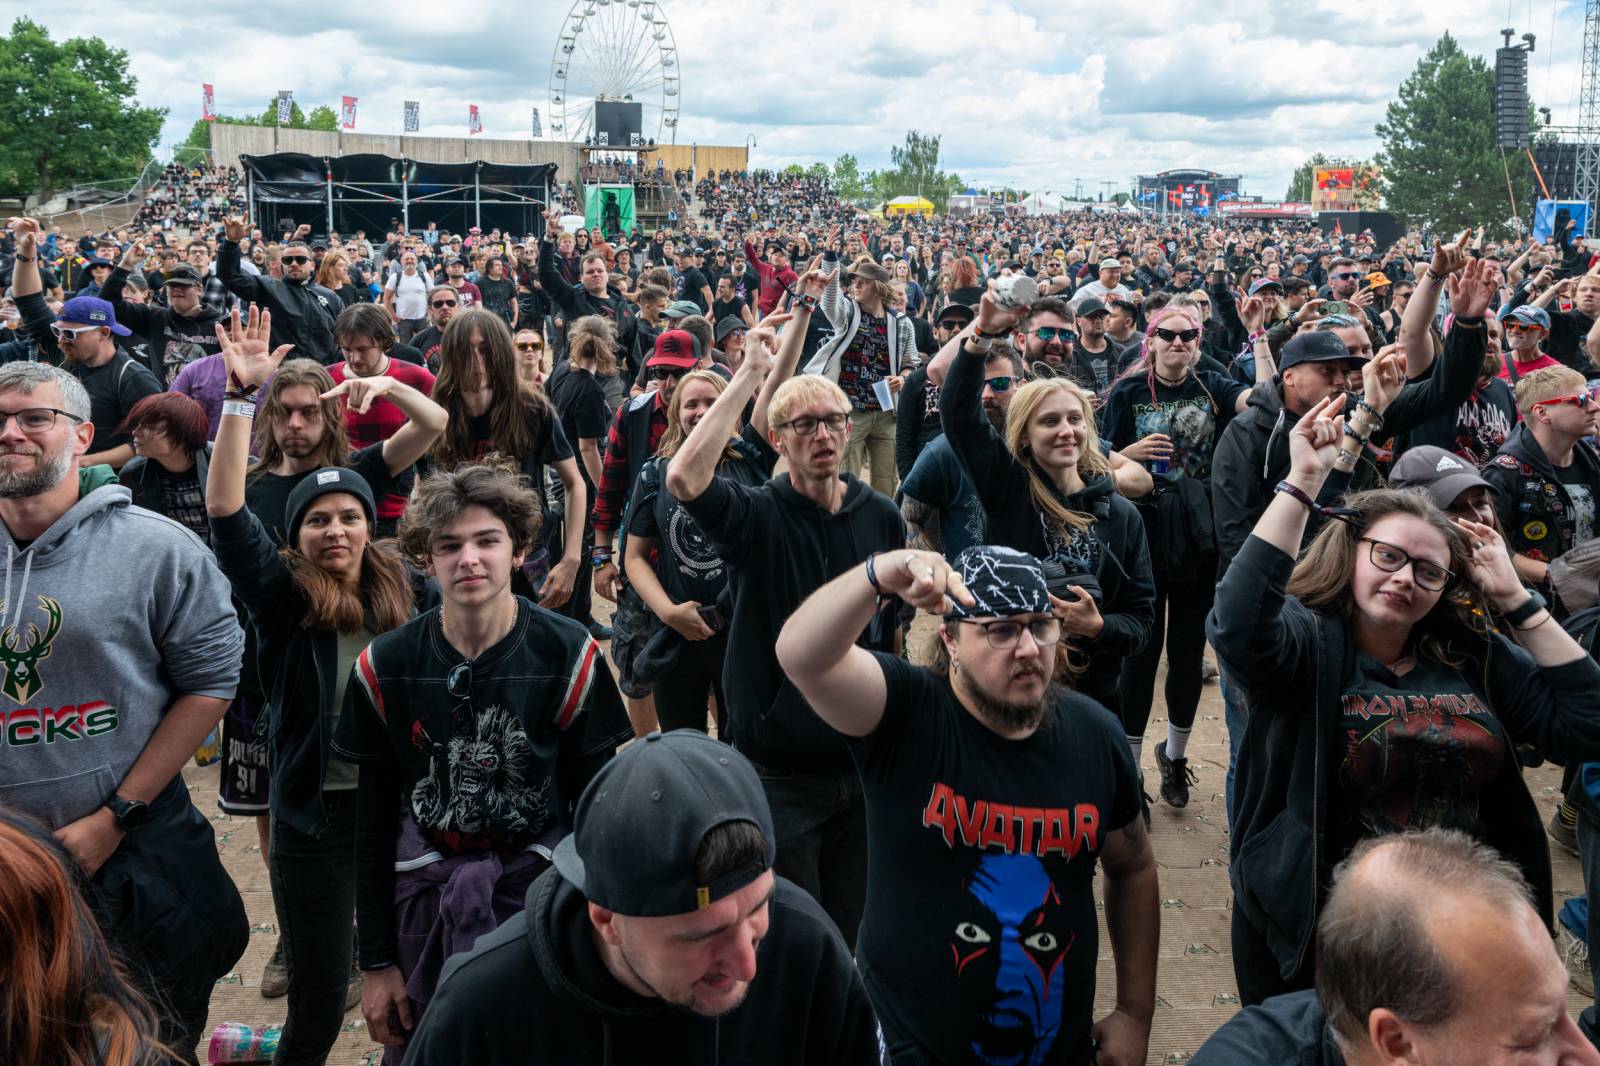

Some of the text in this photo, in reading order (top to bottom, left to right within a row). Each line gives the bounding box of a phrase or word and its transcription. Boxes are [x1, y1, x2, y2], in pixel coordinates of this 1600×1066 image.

[0, 700, 119, 747] CKS
[1341, 693, 1494, 722] IRON MAIDEN
[922, 782, 1100, 864] AVATAR
